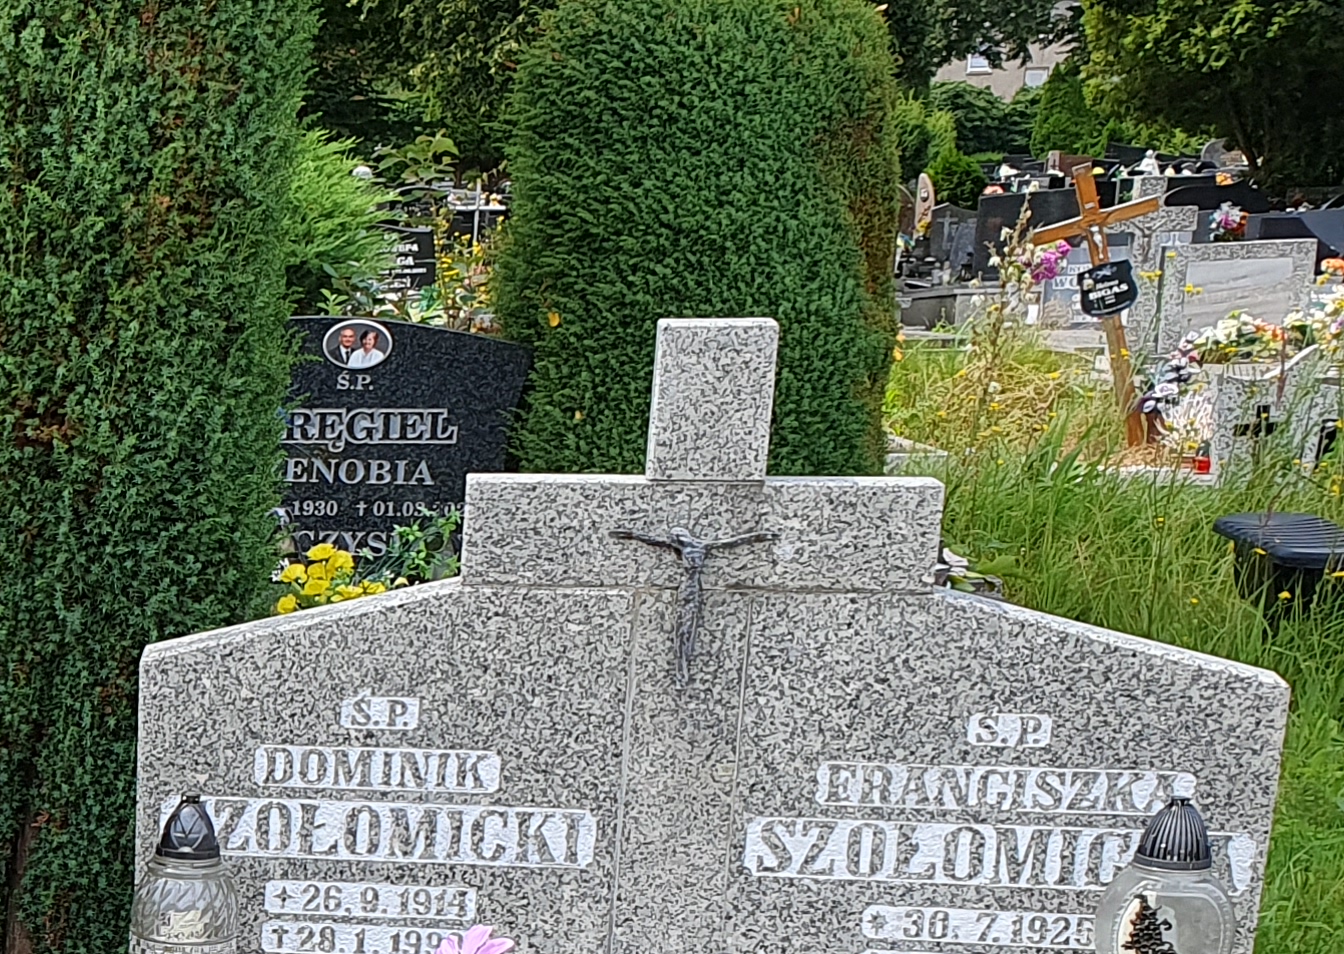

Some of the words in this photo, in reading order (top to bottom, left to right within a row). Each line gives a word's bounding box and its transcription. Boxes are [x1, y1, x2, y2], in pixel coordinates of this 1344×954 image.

[336, 371, 374, 391] Ś.P.
[281, 408, 459, 453] RĘGIEL
[284, 458, 435, 486] ENOBIA
[291, 500, 339, 517] 1930
[261, 746, 488, 791] DOMINIK
[213, 799, 586, 866] ZOŁOMICKI
